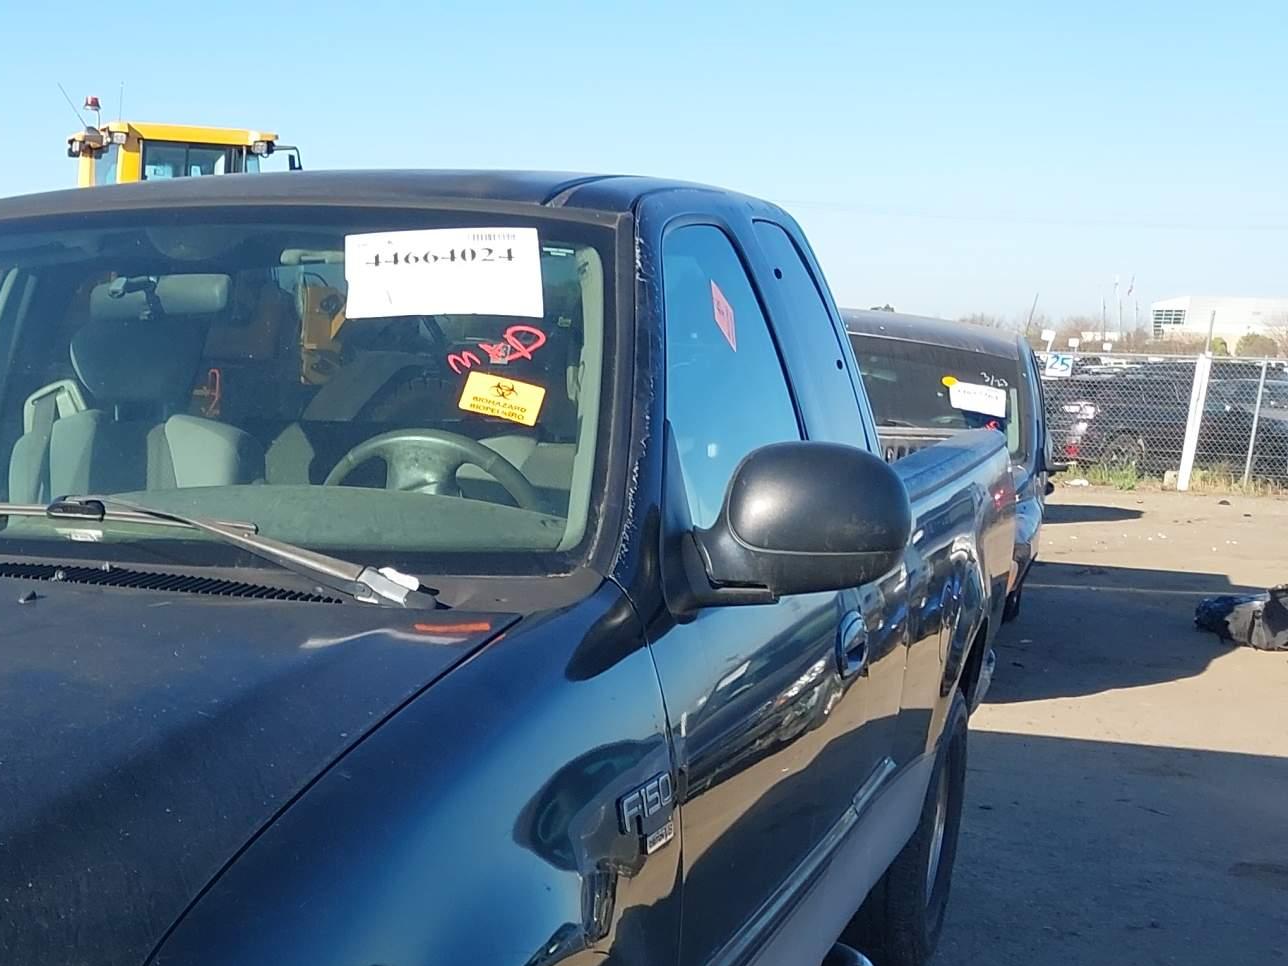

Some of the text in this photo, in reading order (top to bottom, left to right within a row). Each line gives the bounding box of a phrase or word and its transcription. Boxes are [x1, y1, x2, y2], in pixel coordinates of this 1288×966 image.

[365, 247, 516, 267] 44664024
[1048, 354, 1070, 373] 25
[472, 395, 527, 413] BIOHAZARD
